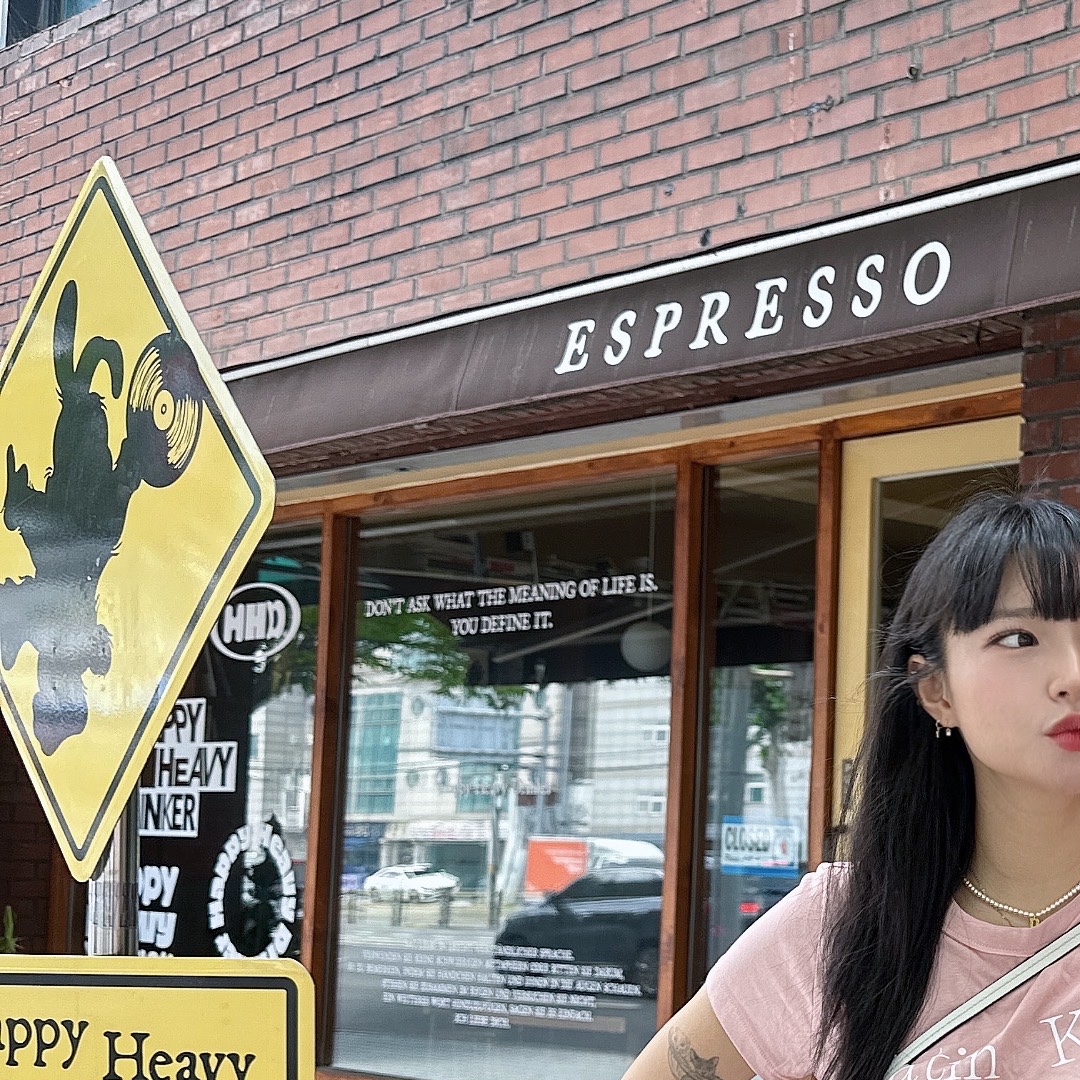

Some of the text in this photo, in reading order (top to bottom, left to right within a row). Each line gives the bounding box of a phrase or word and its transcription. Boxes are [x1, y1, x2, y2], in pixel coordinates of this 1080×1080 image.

[554, 241, 952, 375] ESPRESSO
[364, 598, 405, 618] DON'T
[406, 595, 431, 614] ASK
[433, 591, 475, 611] WHAT
[477, 587, 507, 608] THE
[508, 580, 576, 604] MEANING
[577, 579, 600, 598] OF
[600, 575, 637, 596] LIFE
[222, 599, 287, 644] HHD
[450, 616, 480, 637] YOU
[480, 612, 531, 635] DEFINE
[158, 746, 235, 788] HEAVY
[0, 1017, 90, 1070] ppy
